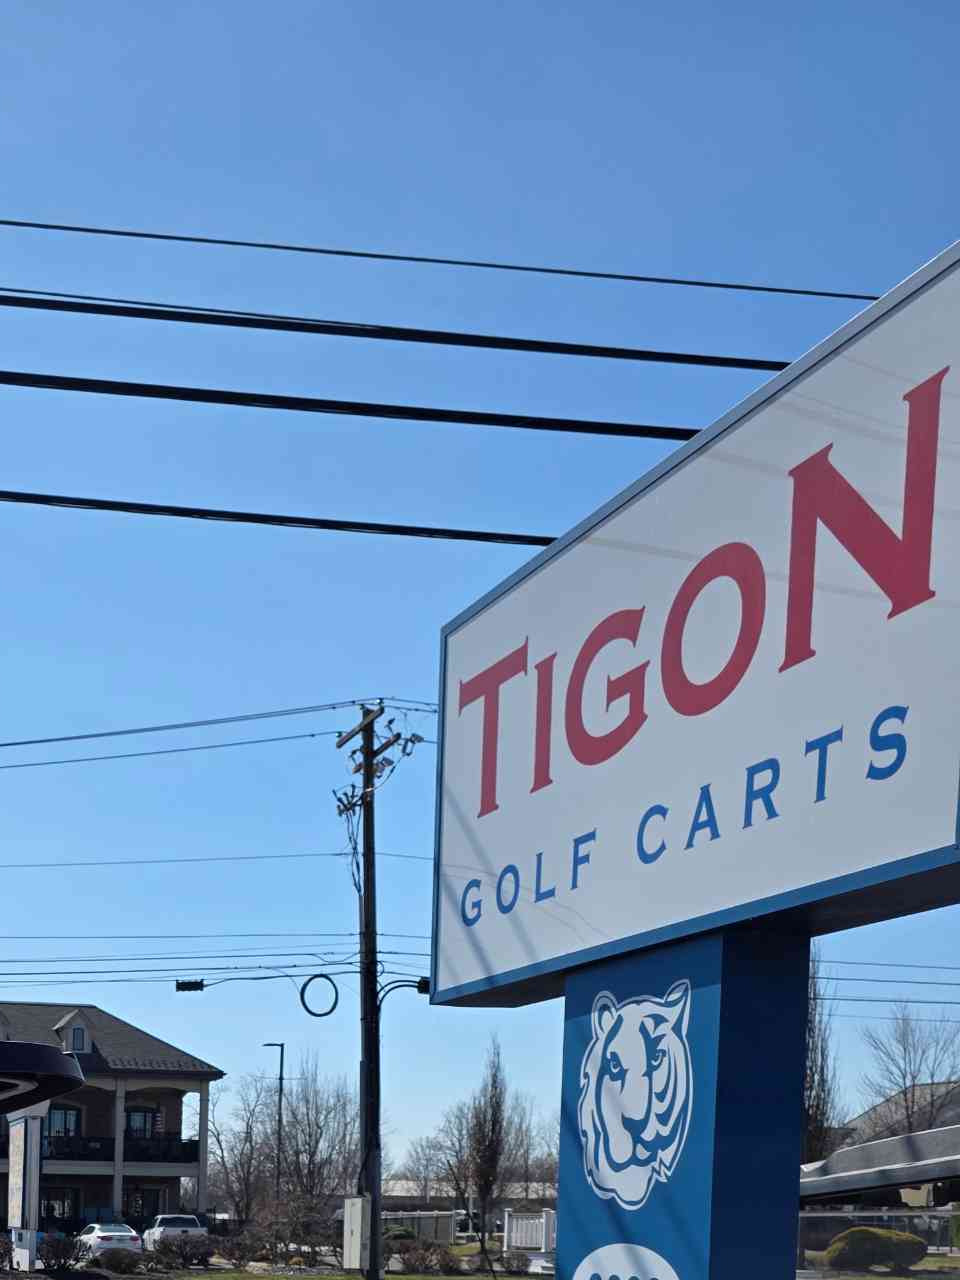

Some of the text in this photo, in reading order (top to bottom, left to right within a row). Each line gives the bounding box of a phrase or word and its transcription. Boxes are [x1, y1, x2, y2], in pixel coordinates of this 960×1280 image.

[458, 365, 951, 819] TIGON
[460, 705, 909, 928] GOLF CARTS
